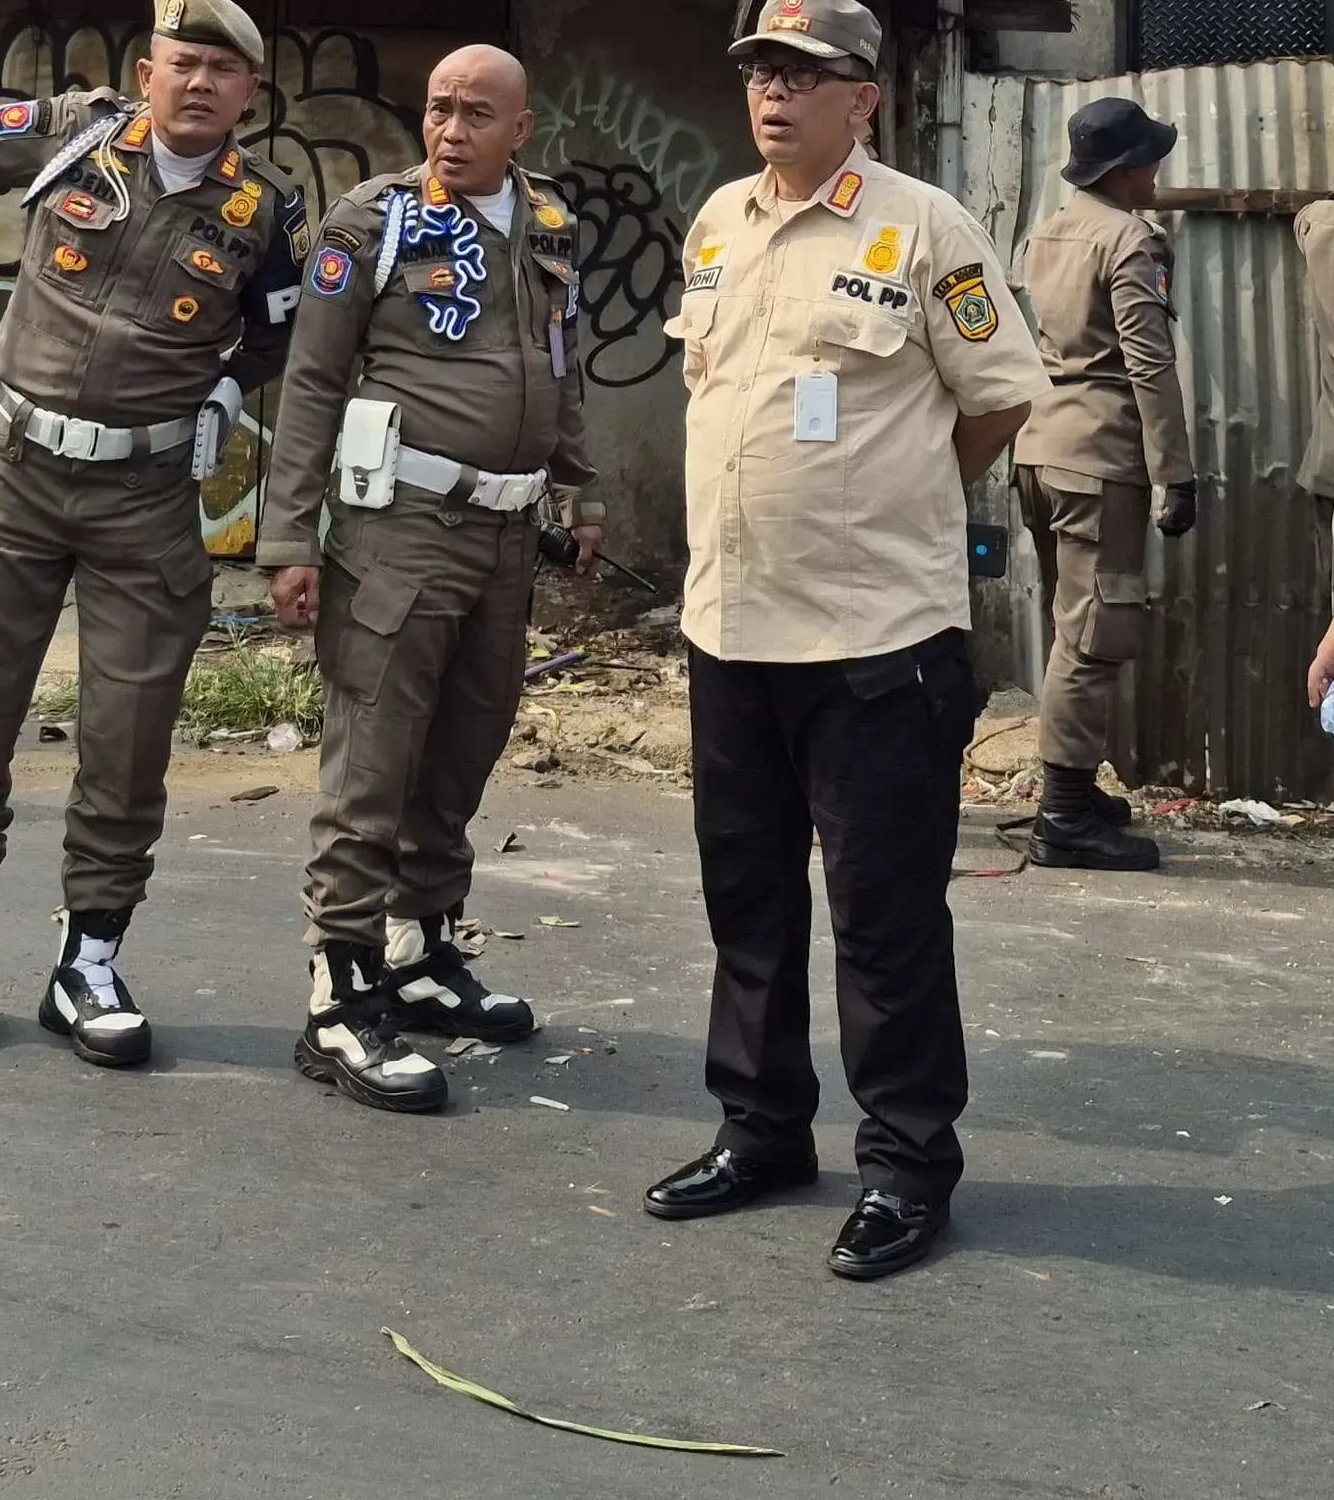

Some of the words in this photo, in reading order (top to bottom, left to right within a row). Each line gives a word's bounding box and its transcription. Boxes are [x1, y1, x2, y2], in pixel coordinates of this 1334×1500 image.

[190, 216, 226, 248] POL
[228, 235, 251, 259] PP
[832, 274, 873, 302] POL
[878, 286, 908, 310] PP
